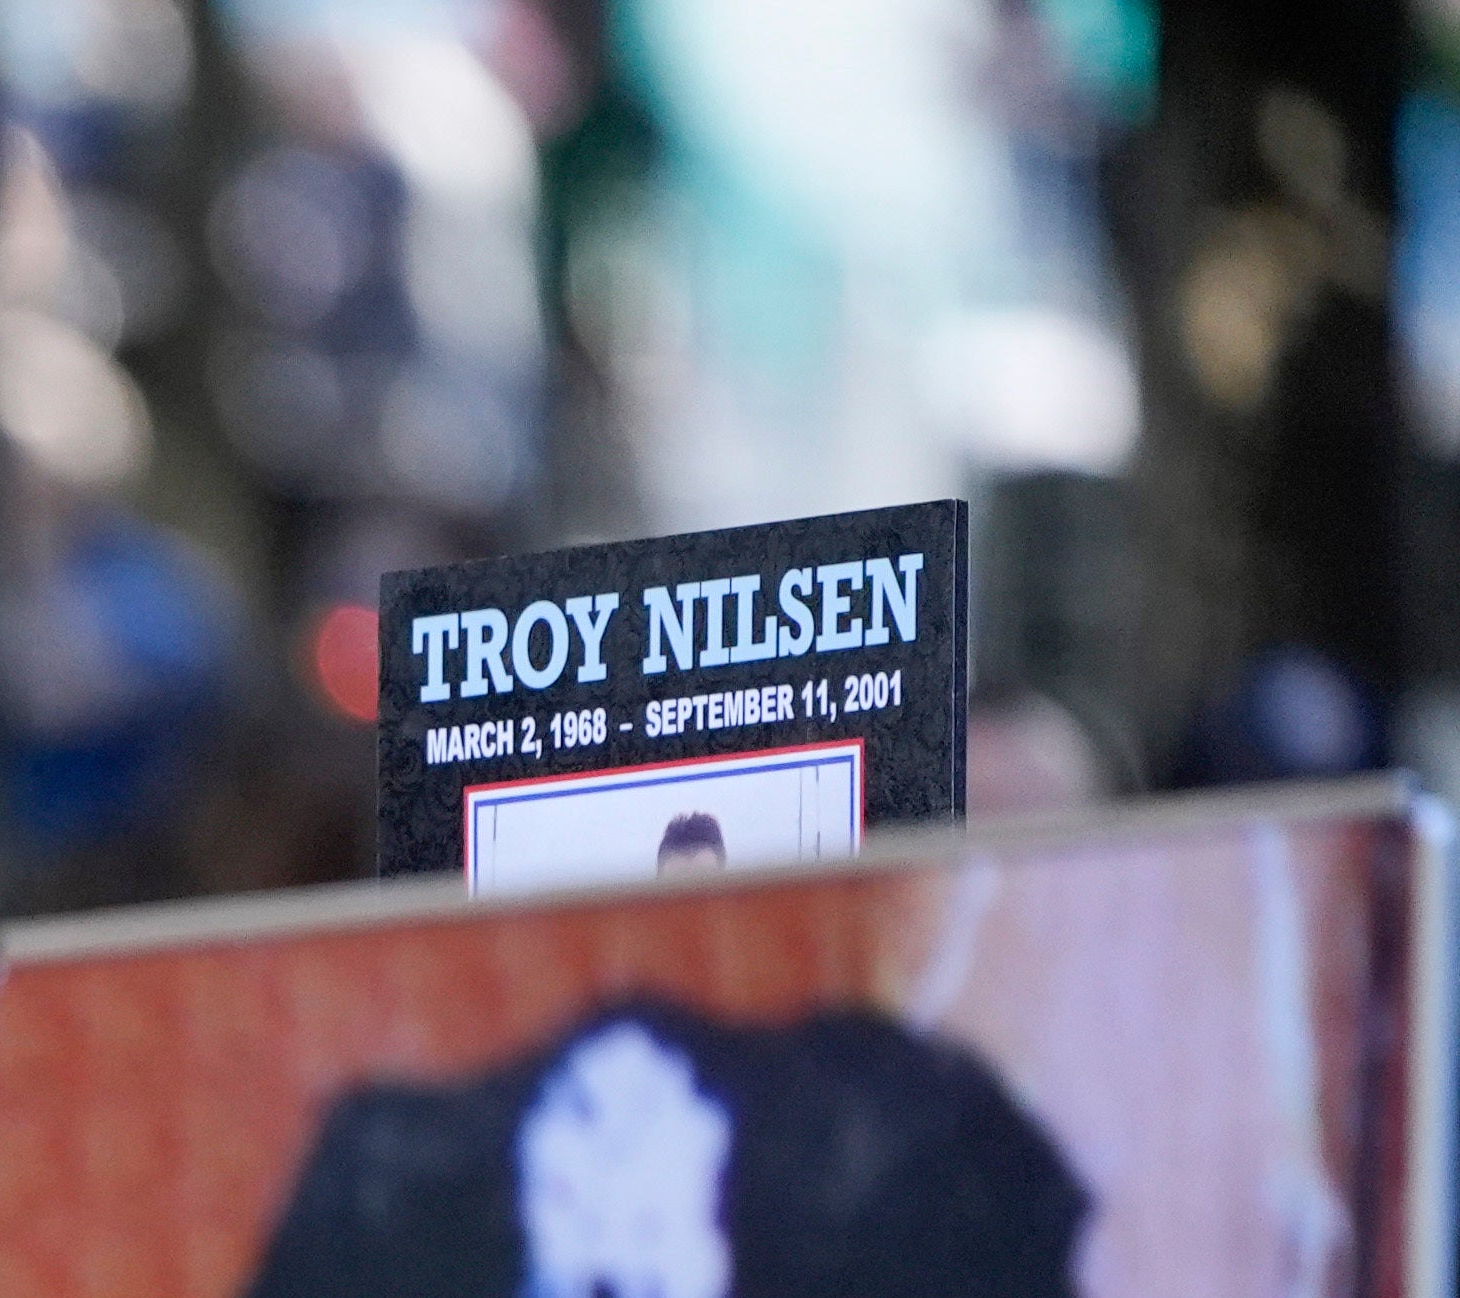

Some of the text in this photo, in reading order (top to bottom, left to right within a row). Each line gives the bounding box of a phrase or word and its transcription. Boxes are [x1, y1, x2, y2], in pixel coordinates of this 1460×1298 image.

[412, 553, 925, 703] TROY NILSEN
[426, 719, 515, 765] MARCH
[519, 717, 544, 760] 2,
[549, 707, 607, 749] 1968
[644, 683, 795, 738] SEPTEMBER
[800, 678, 838, 723] 11,
[843, 669, 903, 713] 2001
